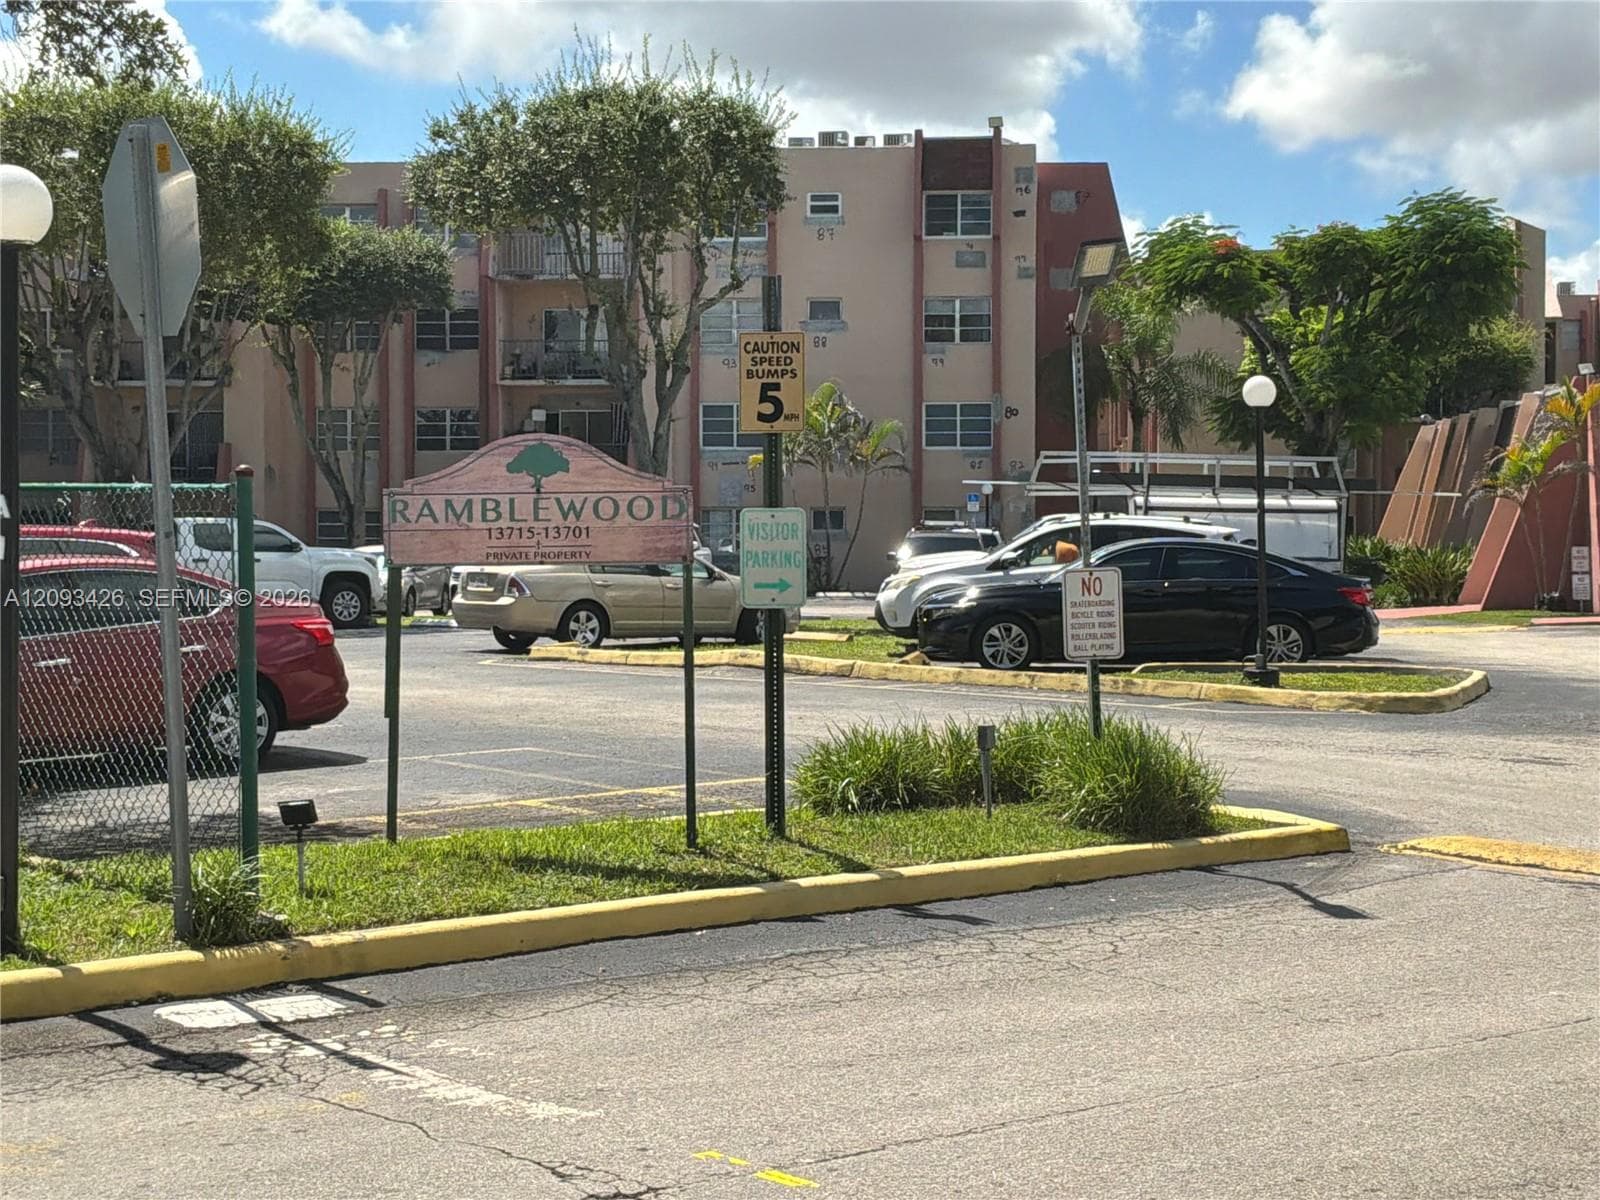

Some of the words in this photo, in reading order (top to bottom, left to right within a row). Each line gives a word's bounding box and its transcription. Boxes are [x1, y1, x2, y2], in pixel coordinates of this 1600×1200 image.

[816, 227, 834, 241] 87
[743, 341, 800, 354] CAUTION
[813, 336, 827, 348] 88
[750, 356, 793, 367] SPEED
[746, 368, 798, 380] BUMPS
[756, 382, 784, 424] 5
[783, 412, 800, 422] MPH
[1004, 406, 1019, 420] 80
[389, 495, 689, 524] RAMBLEWOOD
[486, 525, 590, 541] 13715-13701
[747, 522, 800, 541] VISITOR
[485, 550, 532, 561] PRIVATE
[533, 550, 592, 560] PROPERTY
[745, 550, 803, 568] PARKING
[1081, 576, 1103, 597] NO
[1071, 611, 1094, 619] BICYCLE
[1096, 610, 1115, 618] RIDING
[1070, 622, 1095, 630] SCOOTER
[1098, 621, 1117, 629] RIDING
[1073, 644, 1088, 652] BALL
[1090, 643, 1114, 651] PLAYING
